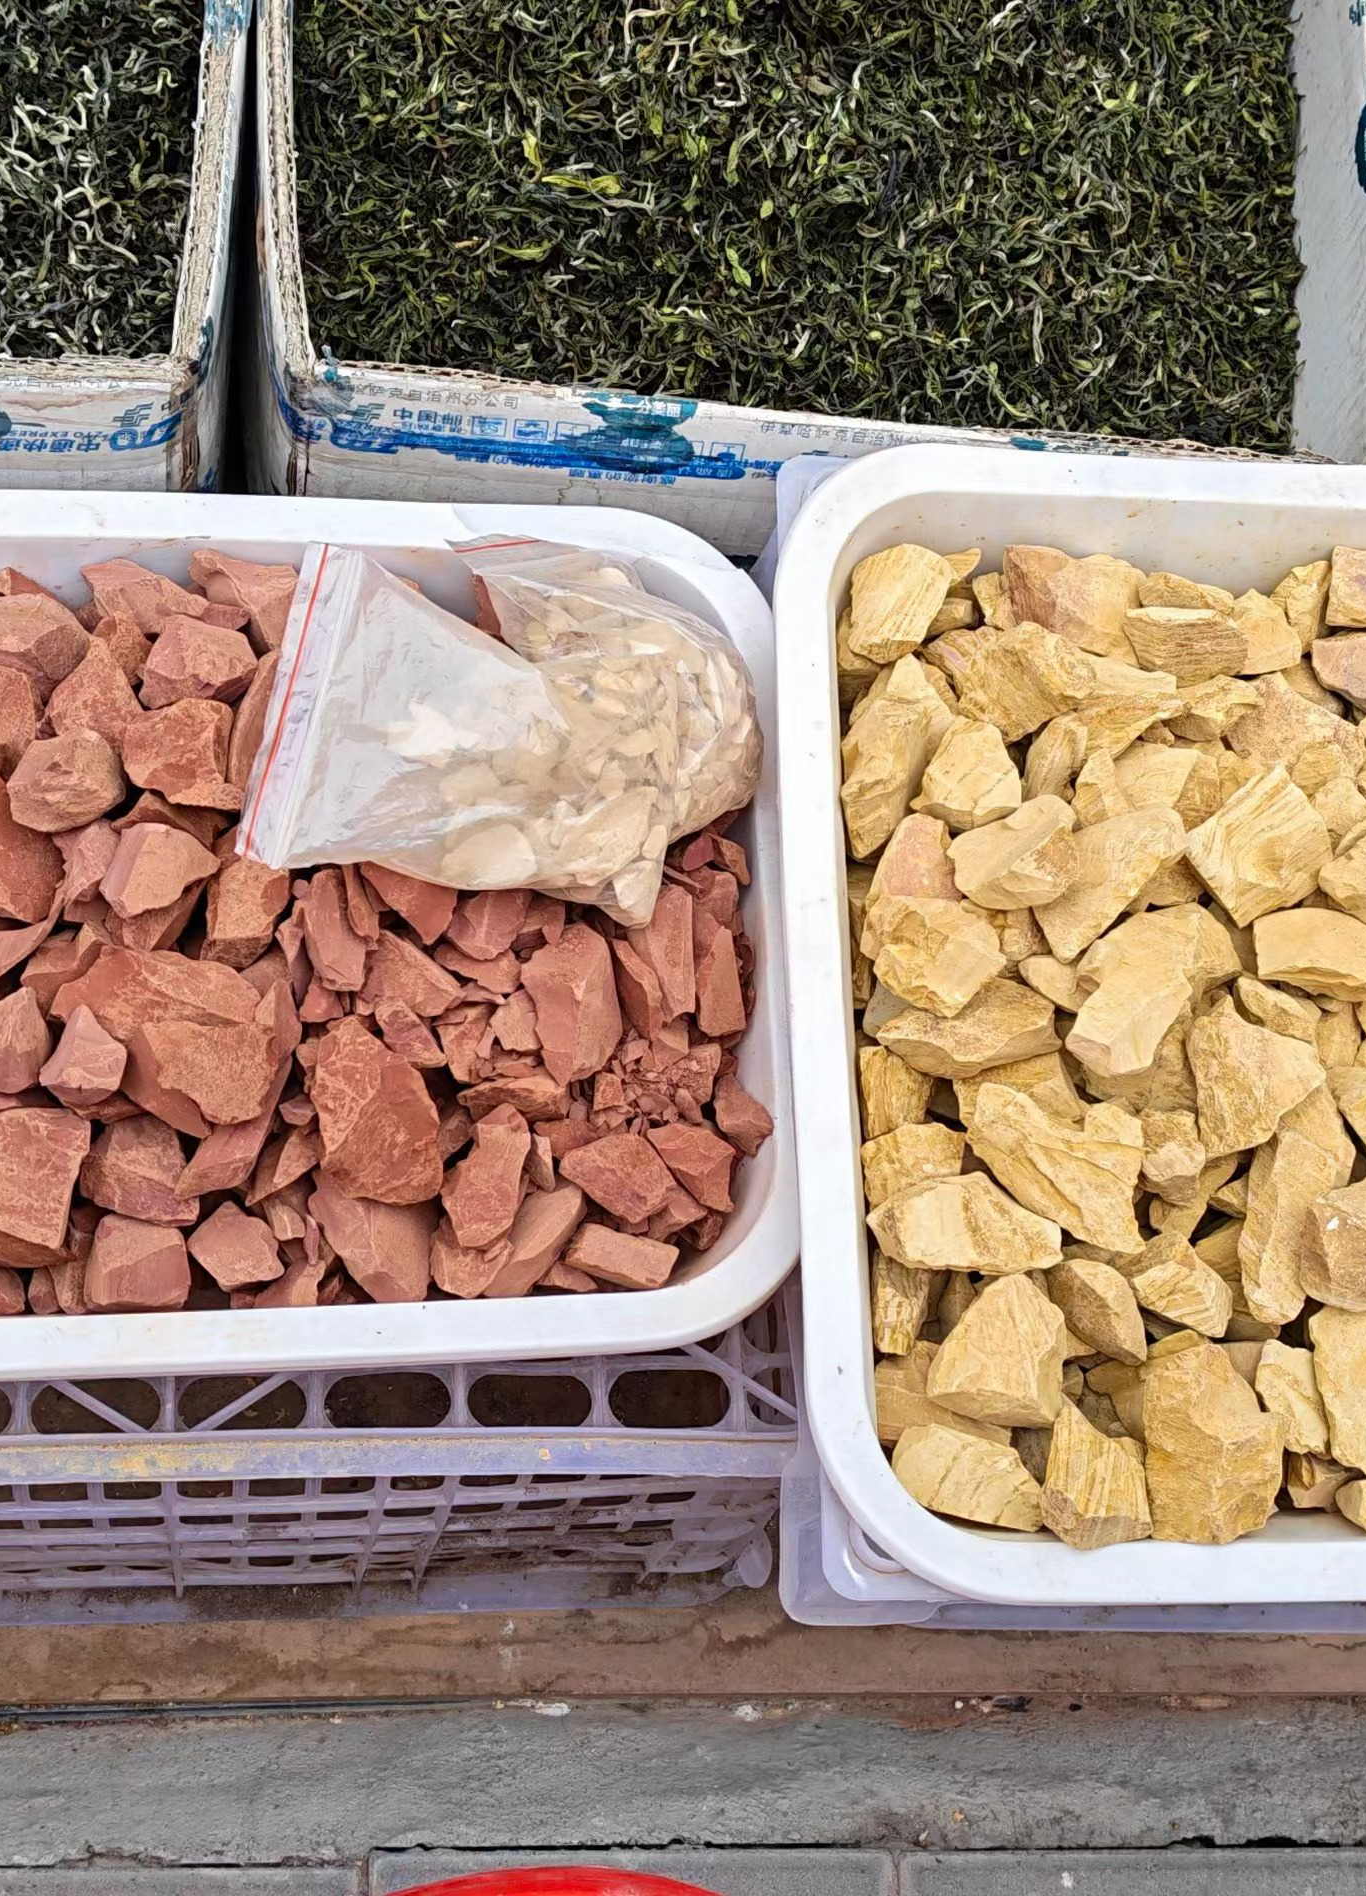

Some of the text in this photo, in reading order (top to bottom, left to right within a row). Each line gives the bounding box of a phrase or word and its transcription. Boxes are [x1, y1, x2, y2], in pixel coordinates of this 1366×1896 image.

[760, 421, 959, 449] 伊犁哈萨克自治州分
